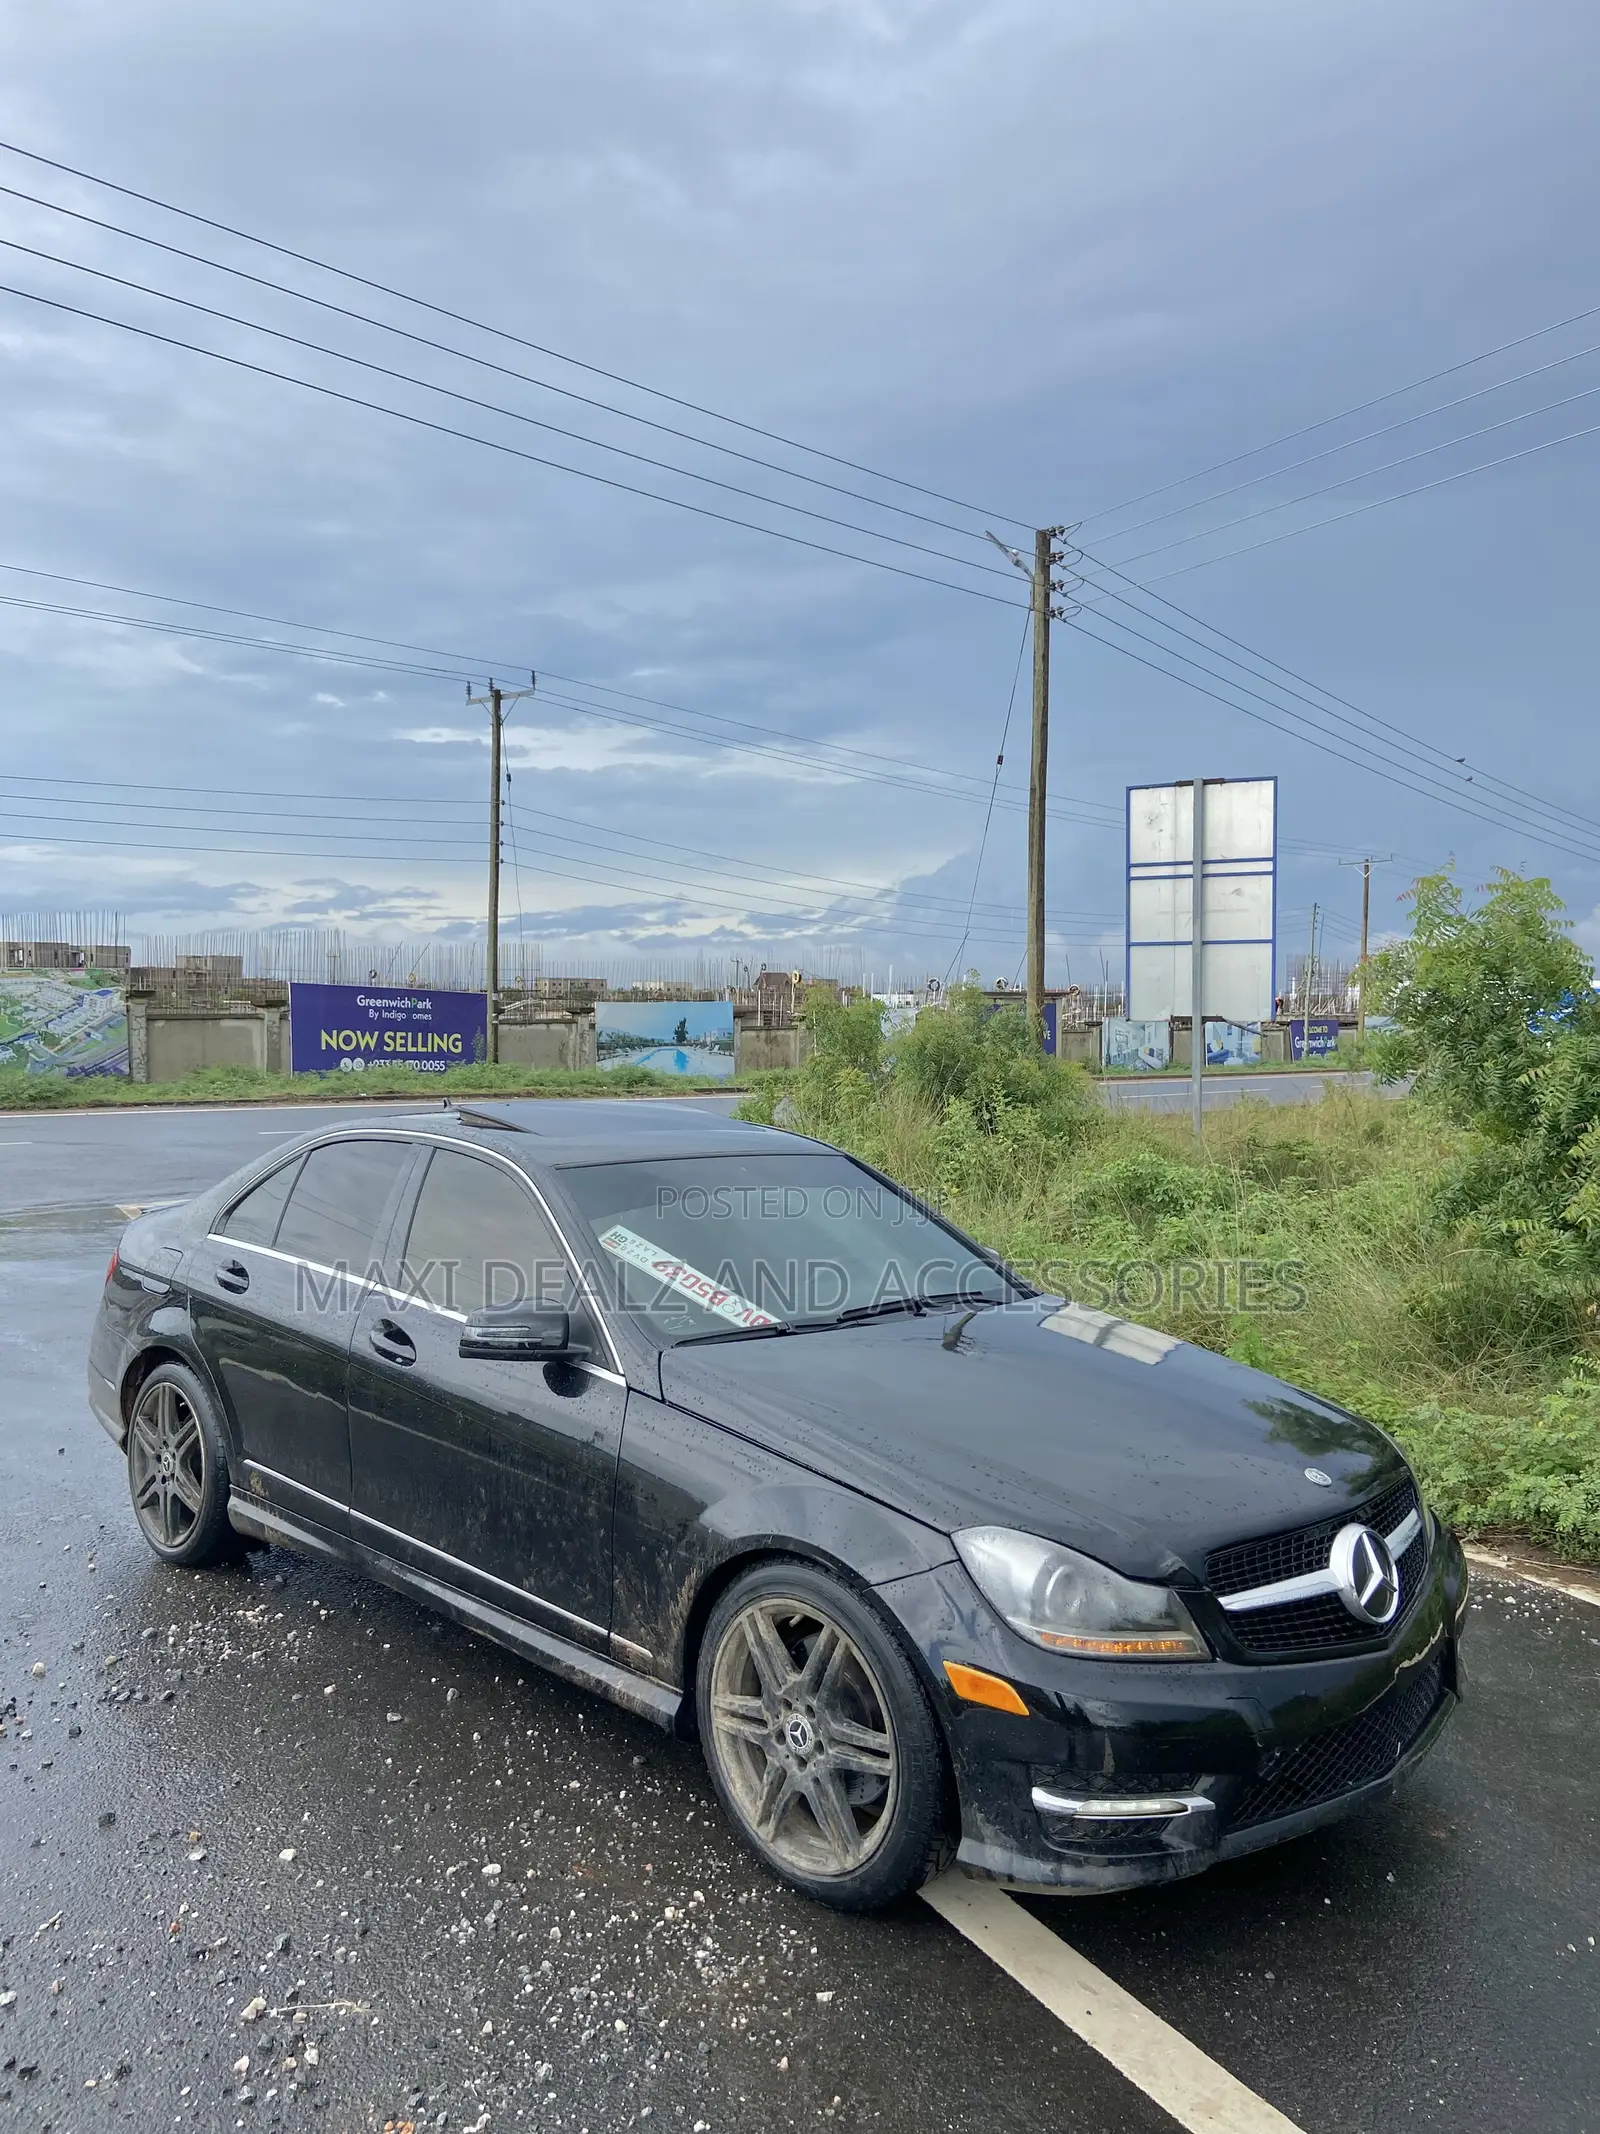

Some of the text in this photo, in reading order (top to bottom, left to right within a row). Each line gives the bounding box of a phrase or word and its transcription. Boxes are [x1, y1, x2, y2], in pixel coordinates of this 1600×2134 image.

[357, 995, 432, 1009] GreenwichPark
[369, 1009, 379, 1020] By
[382, 1010, 407, 1021] Indigo
[321, 1029, 463, 1053] NOW SELLING
[421, 1060, 446, 1071] 0055
[609, 1231, 628, 1244] GH
